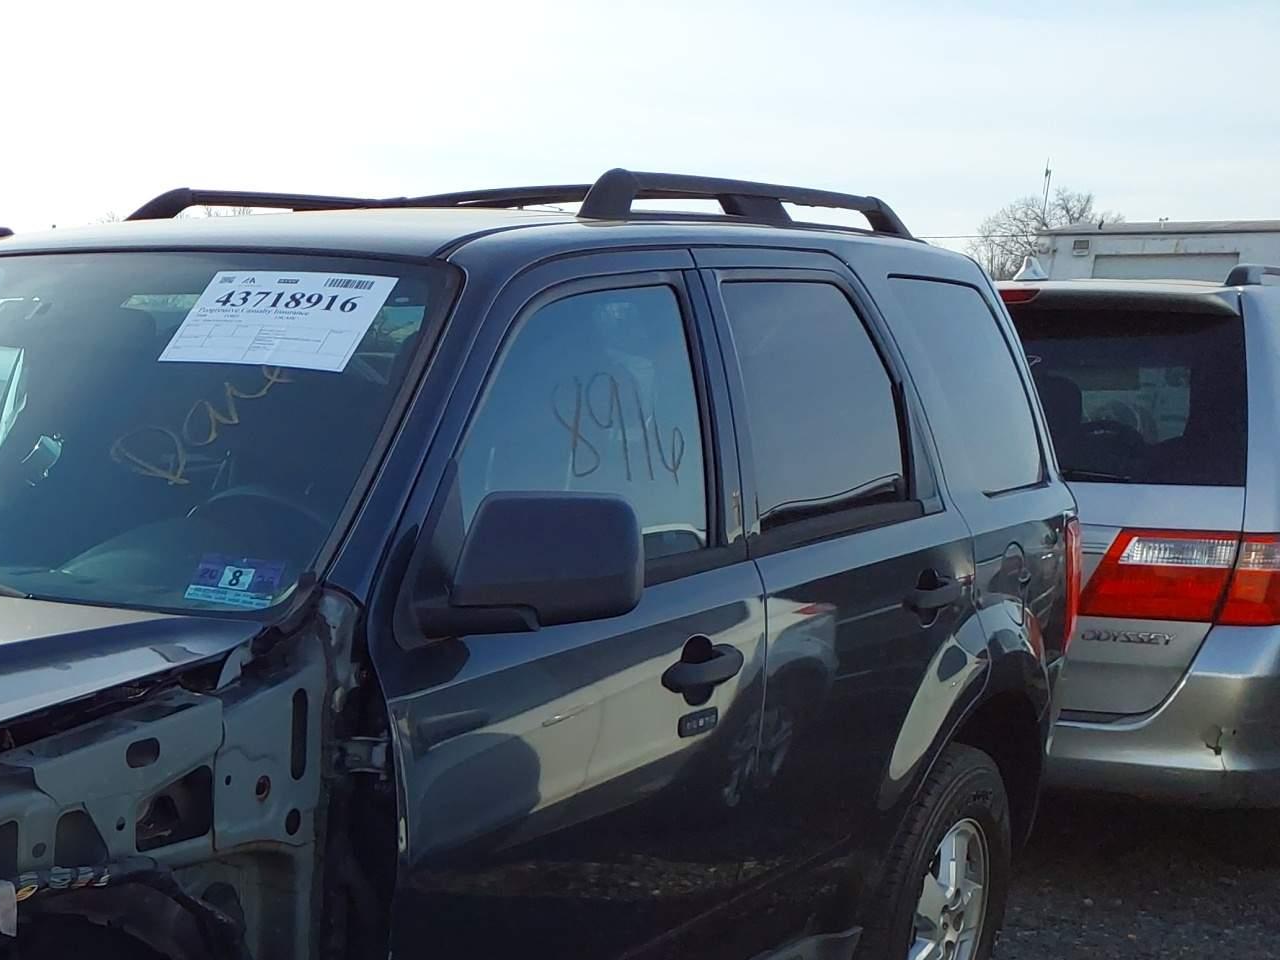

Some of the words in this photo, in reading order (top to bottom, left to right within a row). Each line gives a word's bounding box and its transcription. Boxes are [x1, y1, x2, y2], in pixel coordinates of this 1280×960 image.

[215, 290, 361, 313] 43718916
[552, 372, 685, 486] 8916
[228, 569, 244, 587] 8
[1081, 629, 1175, 645] ODYSSEY
